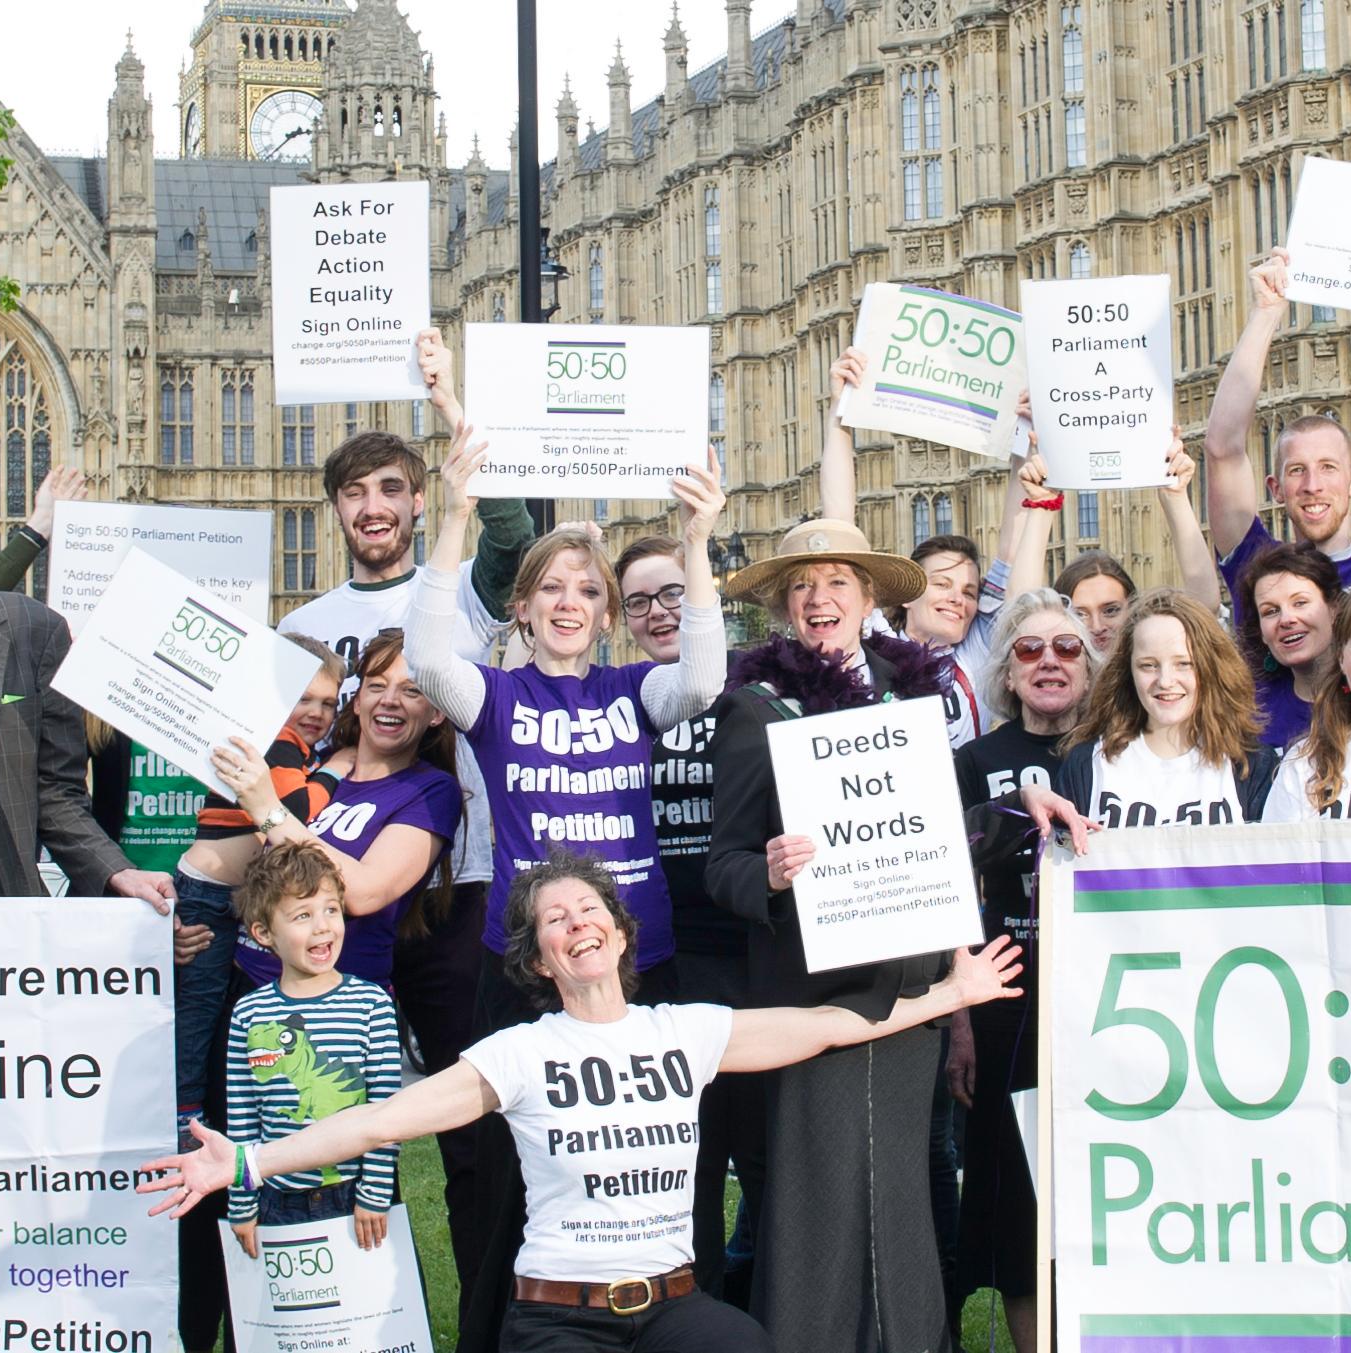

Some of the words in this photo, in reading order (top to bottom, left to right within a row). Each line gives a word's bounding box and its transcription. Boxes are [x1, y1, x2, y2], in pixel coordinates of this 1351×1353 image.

[313, 201, 352, 217] Ask
[360, 200, 395, 216] For
[315, 230, 387, 246] Debate
[317, 258, 384, 274] Action
[310, 286, 393, 305] Equality
[1067, 303, 1129, 324] 50:50
[302, 319, 340, 336] Sign
[347, 317, 402, 332] Online
[891, 303, 1015, 366] 50:50
[291, 338, 411, 350] change.org/5050Parliament
[1052, 334, 1148, 352] Parliament
[300, 355, 406, 365] #5050ParliamentPetition
[547, 352, 626, 380] 50:50
[1095, 362, 1107, 375] A
[882, 344, 1004, 399] Parliament
[546, 383, 625, 404] Parliament
[1049, 385, 1154, 402] Cross-Party
[1058, 411, 1148, 429] Campaign
[542, 445, 569, 456] Sign
[572, 446, 609, 455] Online
[613, 446, 628, 455] at:
[479, 462, 691, 477] change.org/5050Parliament
[66, 523, 92, 537] Sign
[96, 525, 129, 538] 50:50
[132, 528, 195, 543] Parliament
[198, 532, 243, 545] Petition
[65, 540, 114, 552] because
[62, 585, 73, 595] to
[231, 592, 242, 602] in
[209, 577, 228, 588] the
[232, 578, 252, 590] key
[62, 600, 79, 611] the
[171, 606, 240, 662] 50:50
[157, 630, 223, 684] Parliament
[131, 676, 154, 696] Sign
[154, 691, 187, 717] Online
[185, 708, 200, 725] at:
[106, 693, 199, 756] #5050ParliamentPetition
[107, 679, 212, 749] change.org/5050Parliament
[511, 696, 639, 755] 50:50
[812, 725, 908, 761] Deeds
[506, 762, 645, 794] Parliament
[840, 770, 896, 800] Not
[127, 791, 205, 816] Petitio
[531, 812, 635, 841] Petition
[822, 812, 925, 847] Words
[811, 863, 852, 879] What
[857, 859, 870, 872] is
[875, 855, 899, 869] the
[904, 845, 948, 864] Plan?
[853, 878, 875, 889] Sign
[817, 880, 951, 910] change.org/5050Parliament
[816, 894, 960, 925] #5050ParliamentPetition
[56, 965, 161, 996] men
[545, 1049, 693, 1108] 50:50
[584, 1167, 688, 1198] Petition
[13, 1222, 128, 1246] balance
[561, 1220, 582, 1230] Sign
[575, 1233, 596, 1243] Let's
[598, 1233, 623, 1242] forge
[626, 1232, 640, 1241] our
[265, 1247, 333, 1279] 50:50
[8, 1263, 130, 1293] together
[269, 1282, 340, 1301] Parliament
[278, 1340, 298, 1351] Sign
[300, 1338, 334, 1349] Online
[337, 1336, 351, 1345] at:
